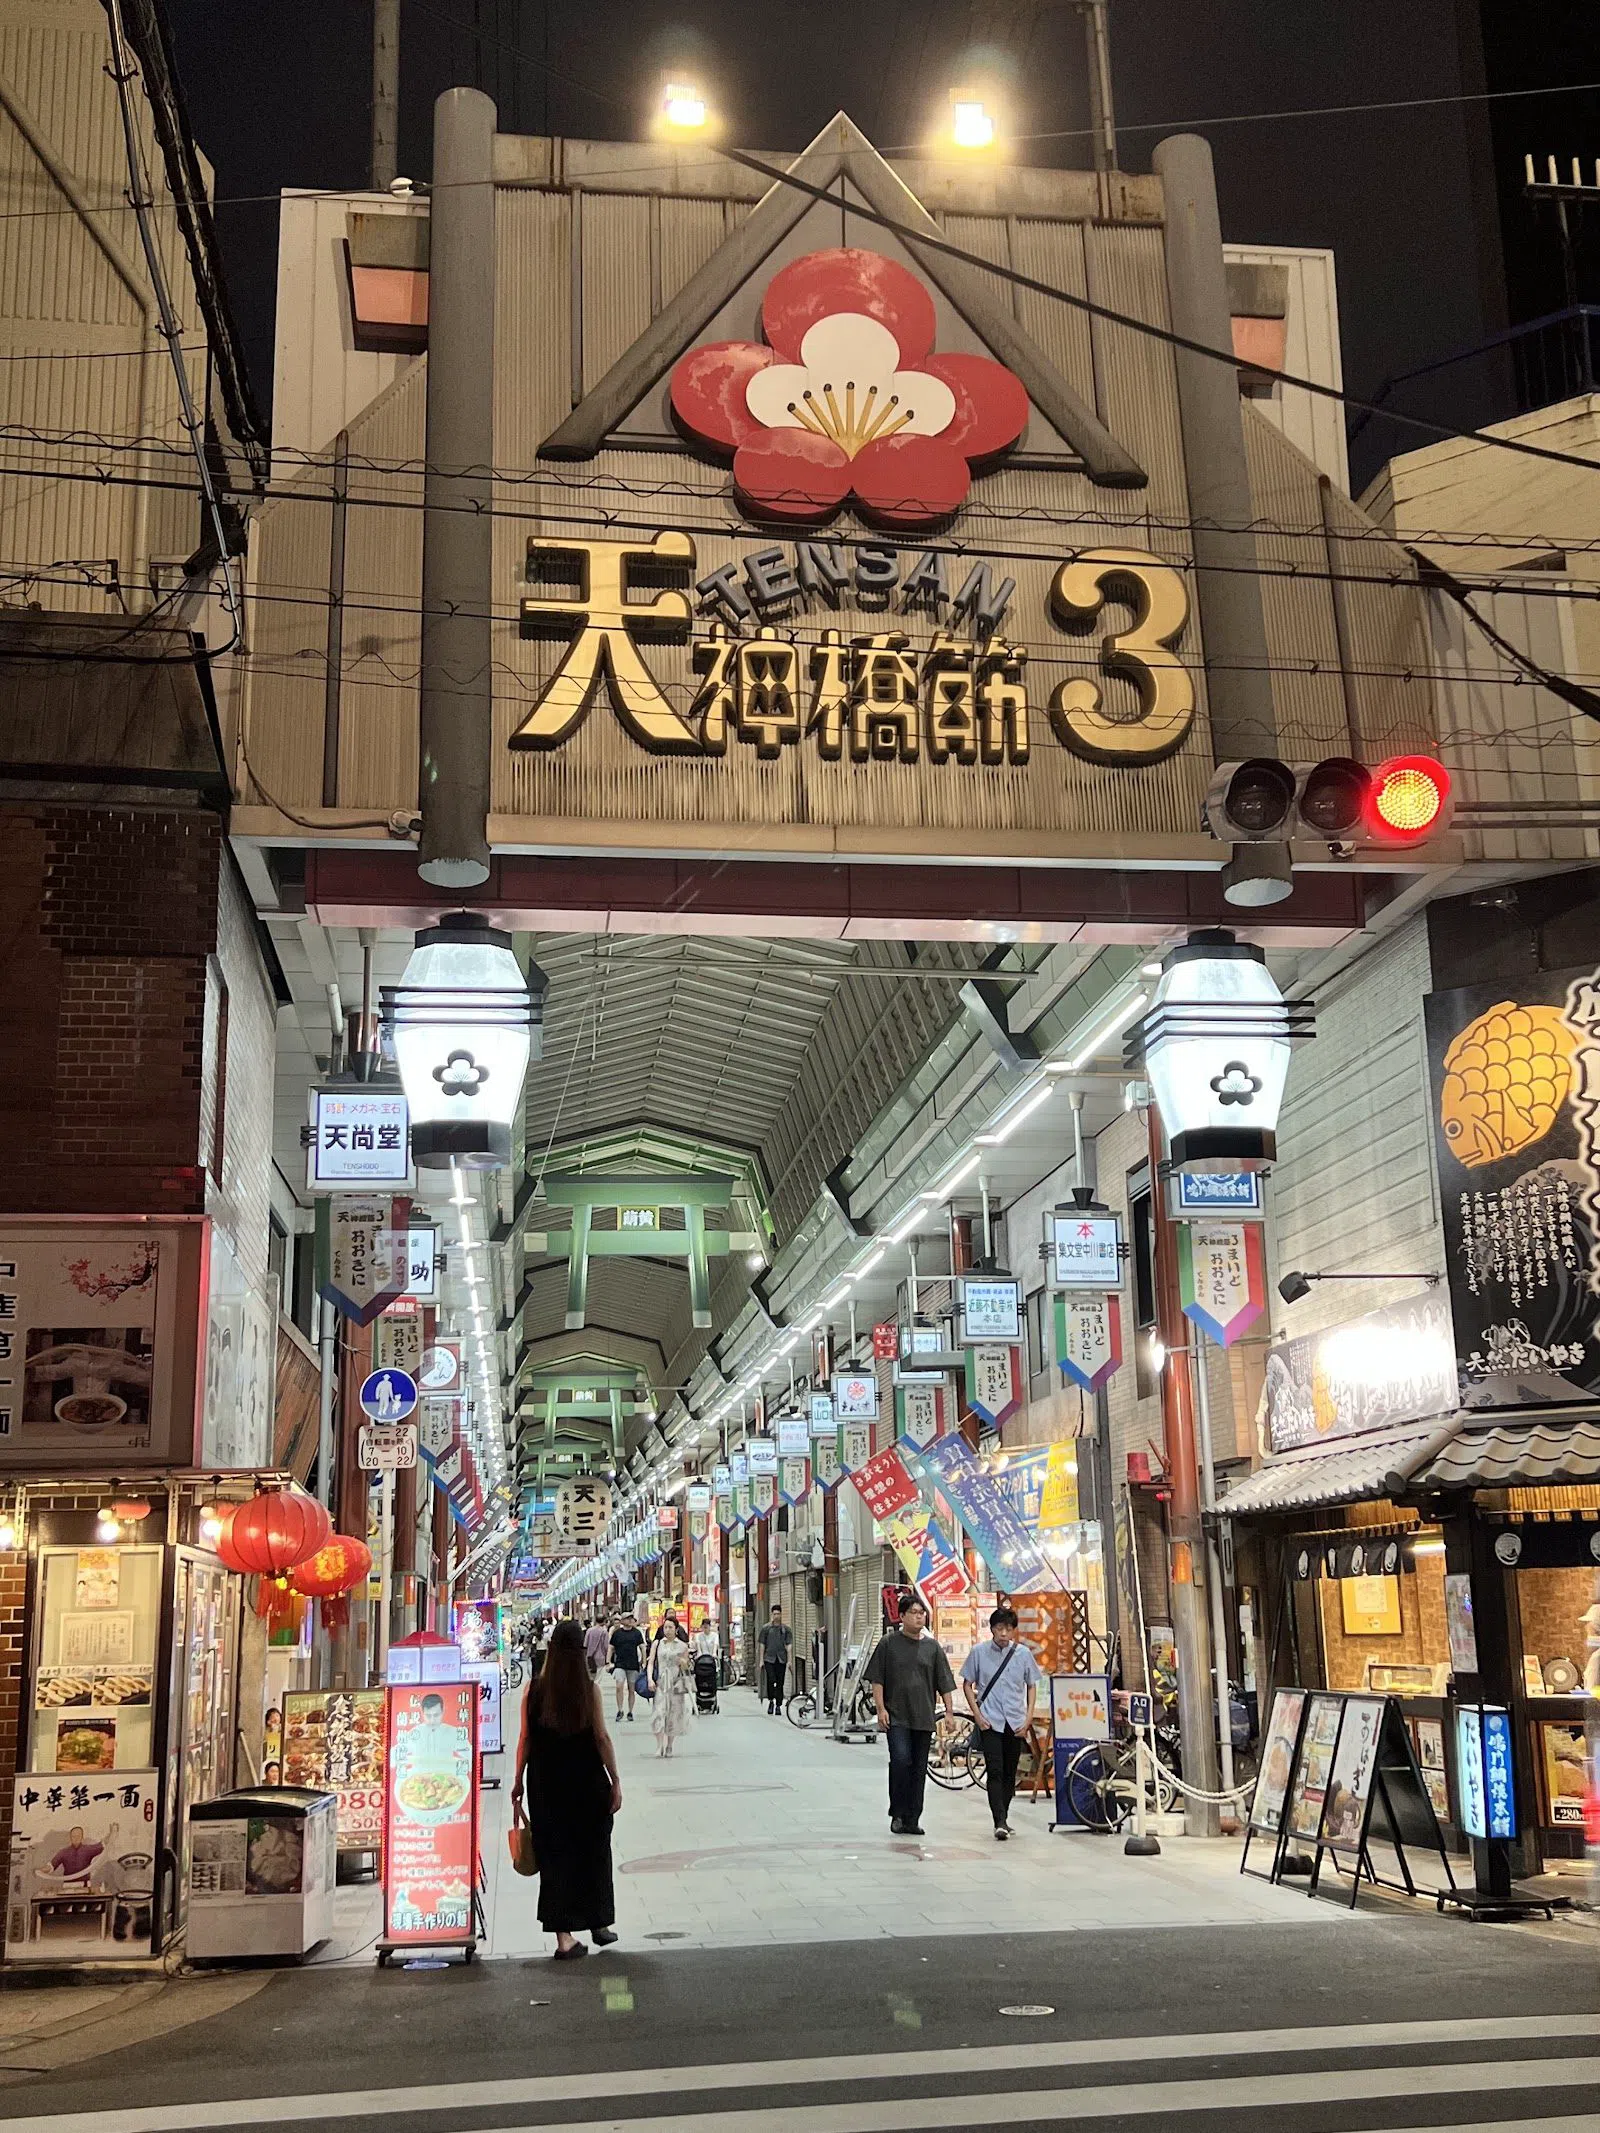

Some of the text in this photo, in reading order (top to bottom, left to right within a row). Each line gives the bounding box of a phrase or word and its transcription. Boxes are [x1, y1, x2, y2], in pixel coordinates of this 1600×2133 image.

[697, 541, 1017, 625] TENSAN
[350, 1104, 378, 1114] メガネ
[324, 1123, 401, 1150] 天尚堂
[1076, 1221, 1095, 1240] 本
[351, 1230, 366, 1286] おおきに
[1227, 1248, 1241, 1287] まいど
[1210, 1252, 1226, 1305] おおきに
[393, 1328, 405, 1367] おおきに
[1080, 1317, 1092, 1361] おおきに
[1094, 1314, 1105, 1346] まいど
[573, 1484, 596, 1531] 天三
[863, 1476, 895, 1500] 理想の
[873, 1492, 906, 1515] 住まい。
[1133, 1696, 1148, 1708] 入口
[1464, 1717, 1479, 1830] たいやき
